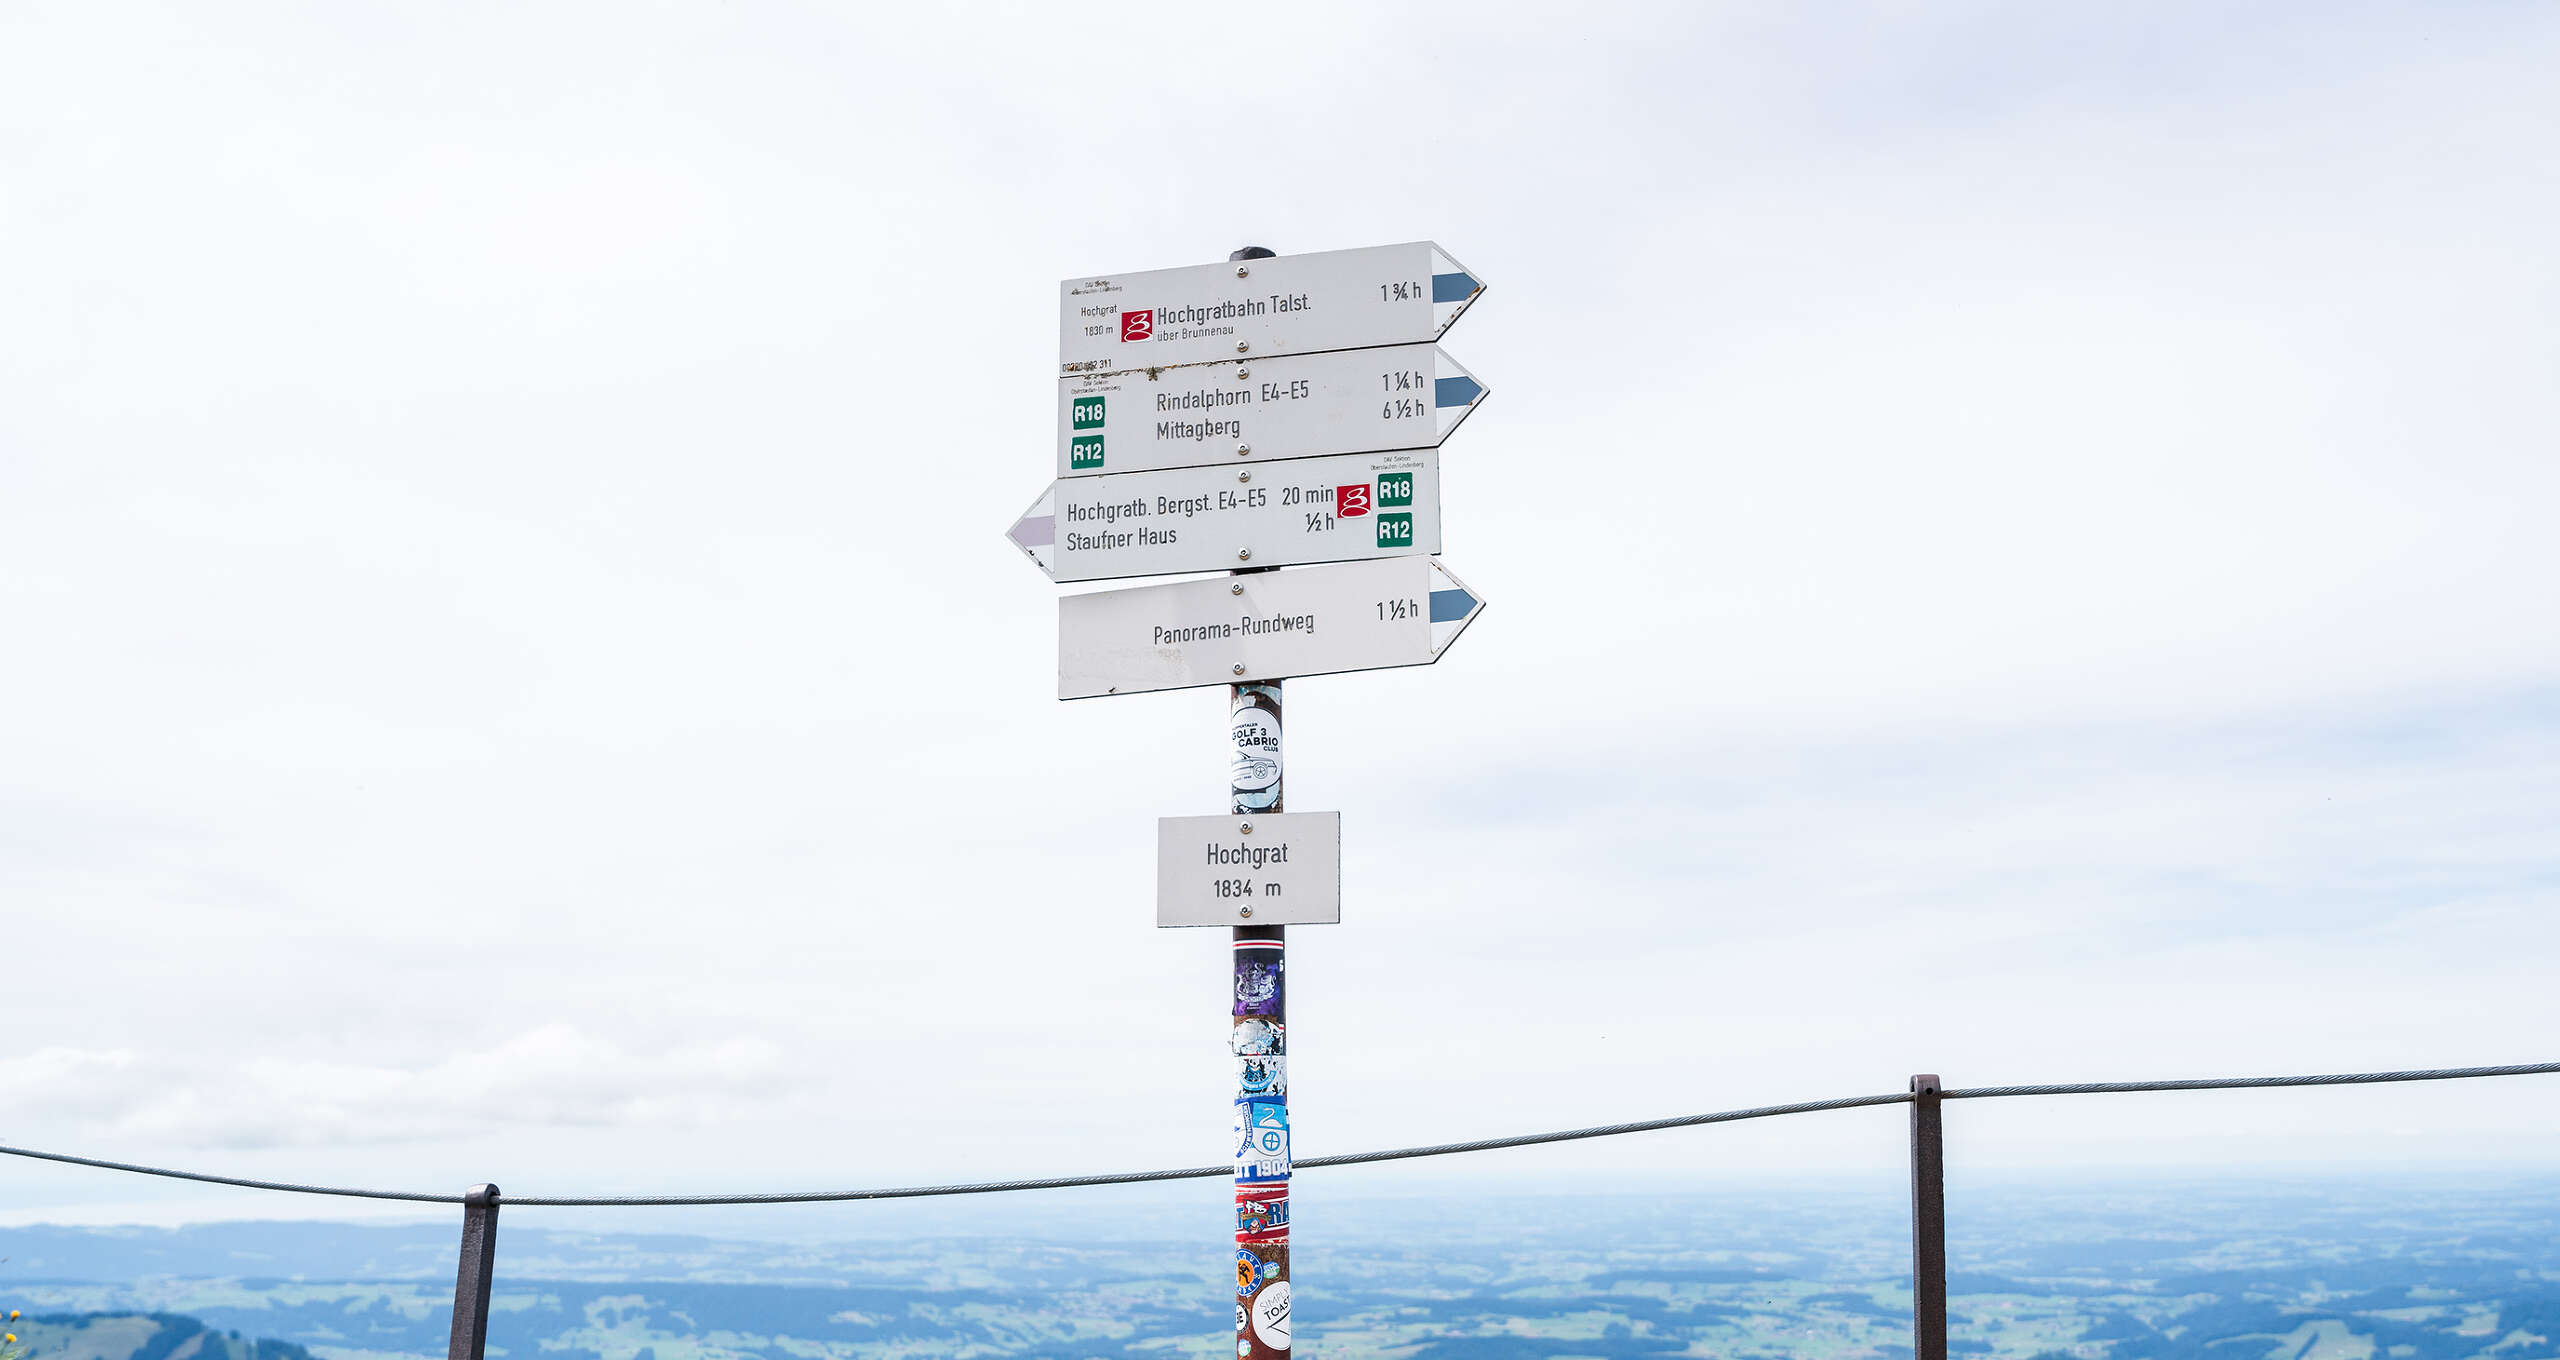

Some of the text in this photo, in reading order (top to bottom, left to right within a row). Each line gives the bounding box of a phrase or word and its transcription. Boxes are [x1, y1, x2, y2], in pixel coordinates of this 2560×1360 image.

[1380, 284, 1388, 302] 1
[1413, 281, 1422, 299] h
[1080, 303, 1118, 319] Hochgrat
[1158, 294, 1312, 326] Hochgratbahn Talst.
[1084, 325, 1114, 337] 1830 m
[1157, 325, 1234, 342] über Brunnenau
[1383, 373, 1389, 392] 1
[1415, 371, 1424, 389] h
[1157, 380, 1309, 412] Rindalphorn E4-E5
[1074, 403, 1104, 423] R18
[1382, 402, 1391, 419] 6
[1416, 399, 1425, 416] h
[1157, 418, 1241, 441] Mittagberg
[1073, 443, 1102, 462] R12
[1379, 480, 1411, 499] R18
[1067, 485, 1334, 524] Hochgratb. Bergst. E4-E5 20 min
[1325, 512, 1335, 531] h
[1378, 520, 1410, 539] R12
[1066, 527, 1178, 552] Staufner Haus
[1376, 601, 1384, 620] 1
[1409, 599, 1419, 617] h
[1153, 612, 1315, 646] Panorama-Rundweg
[1261, 728, 1267, 736] 3
[1238, 737, 1278, 748] CABRIO
[1207, 842, 1288, 870] Hochgrat
[1213, 879, 1281, 898] 1834 m
[1259, 1288, 1289, 1311] SIMPLY
